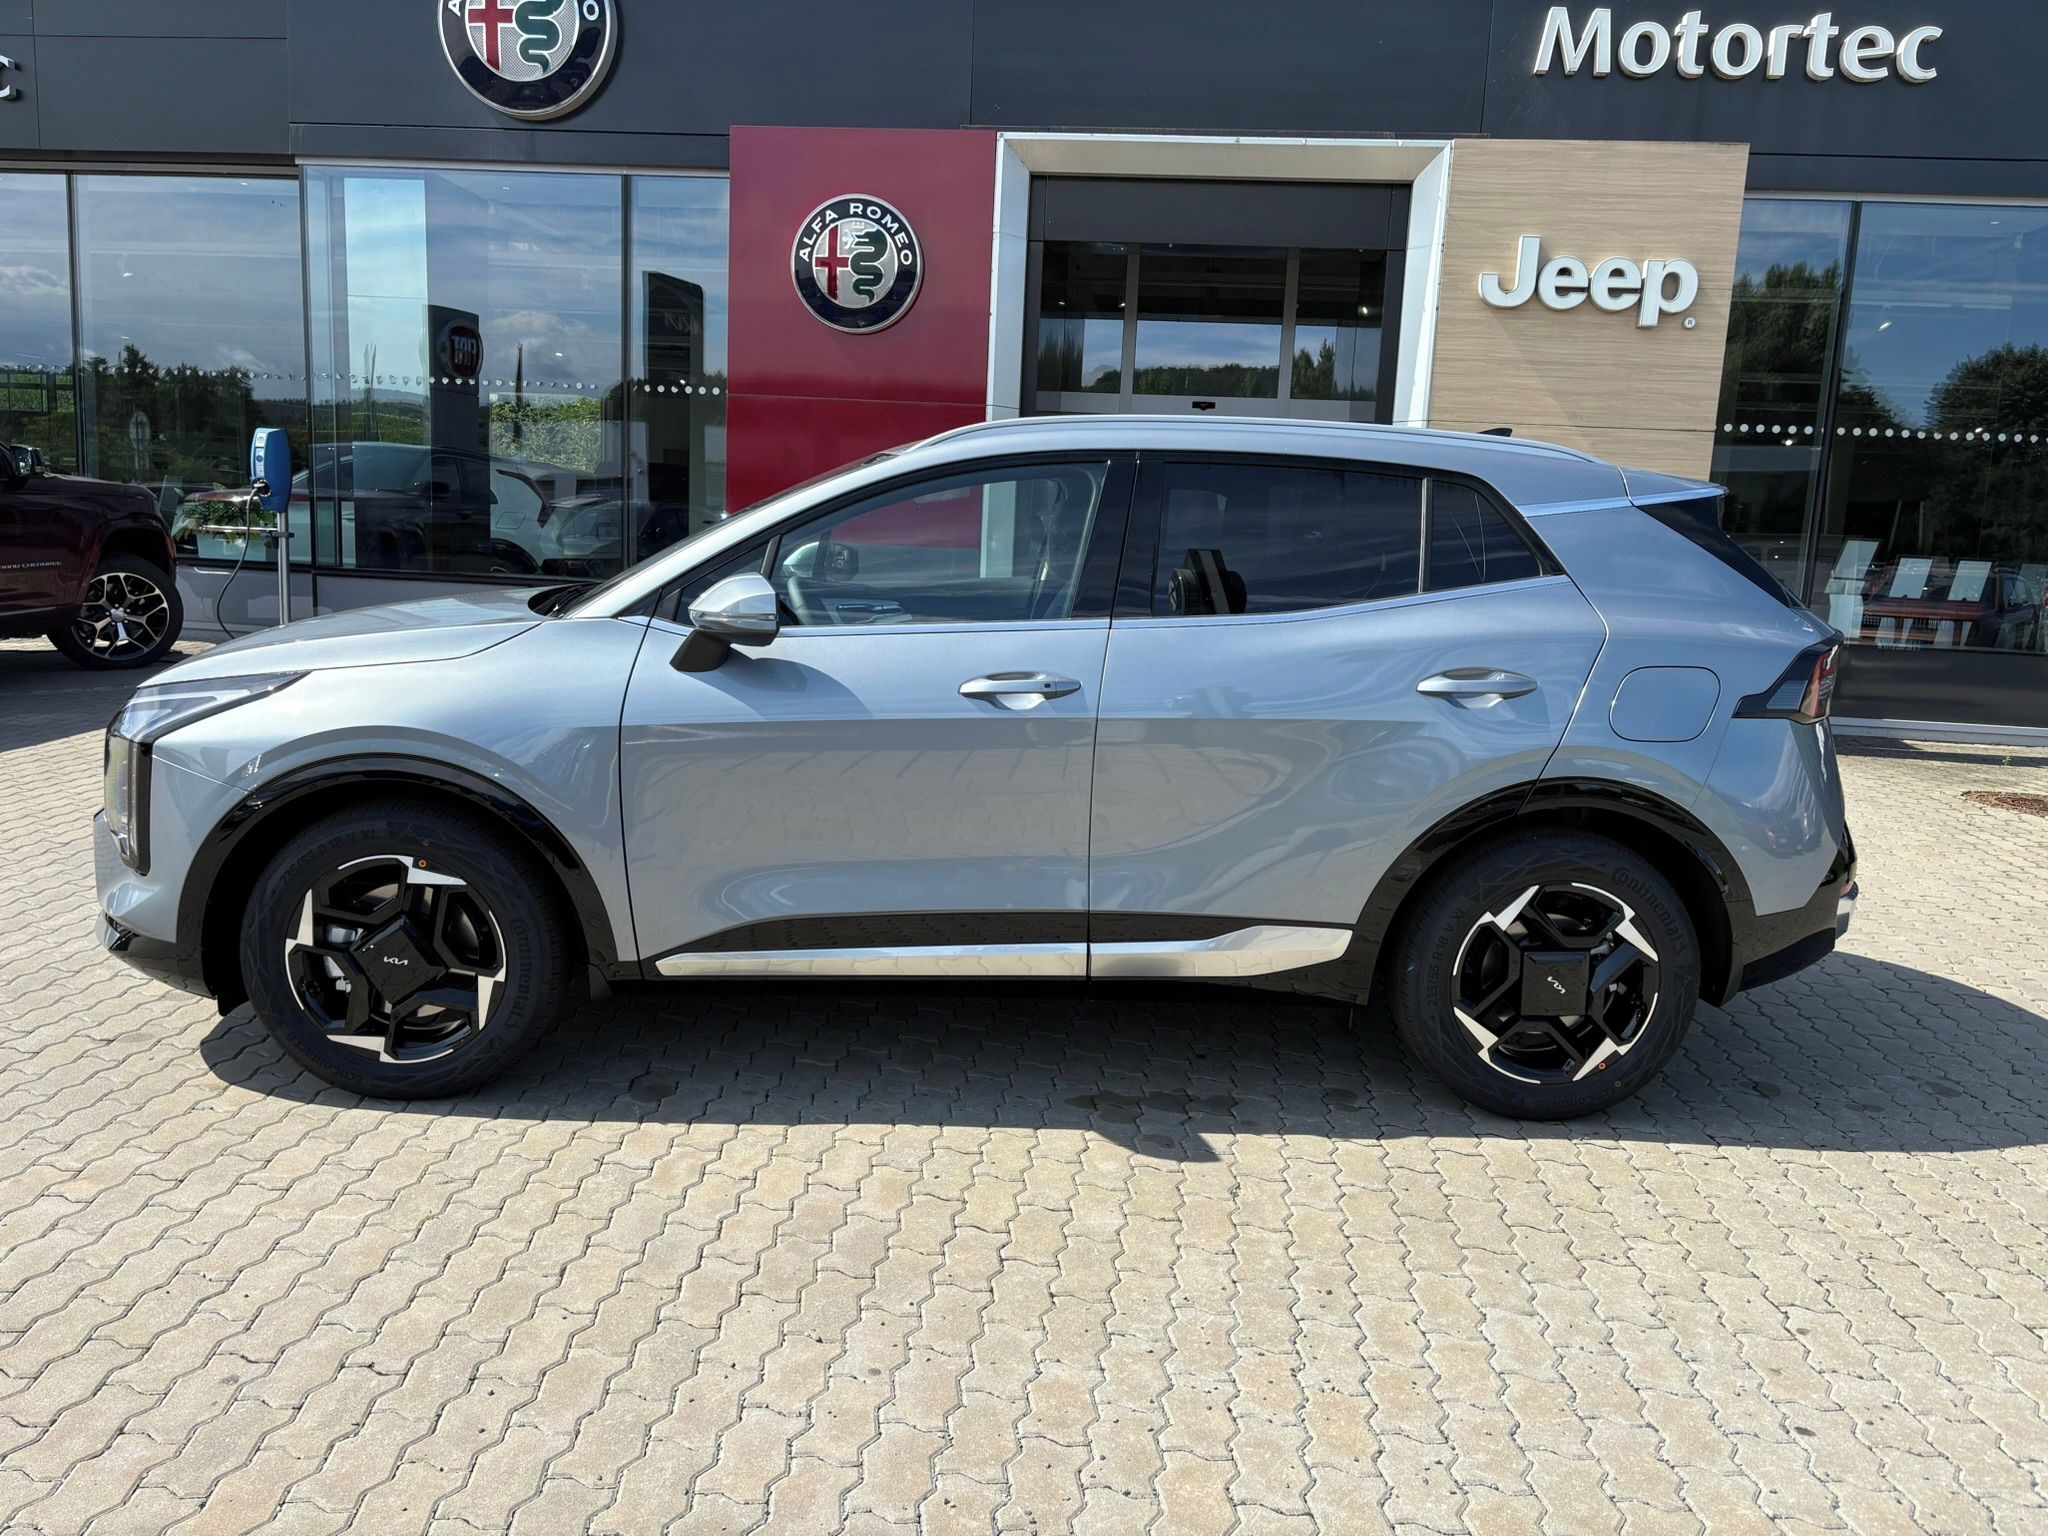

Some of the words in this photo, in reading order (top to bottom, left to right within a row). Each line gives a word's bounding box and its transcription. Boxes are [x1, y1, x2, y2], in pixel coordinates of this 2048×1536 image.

[1534, 7, 1943, 83] Motortec
[799, 209, 839, 262] ALFA
[849, 202, 913, 265] ROMEO
[1477, 234, 1699, 328] Jeep
[1612, 866, 1685, 943] Continental
[510, 917, 533, 1018] Continental
[1426, 964, 1441, 1007] 235/55
